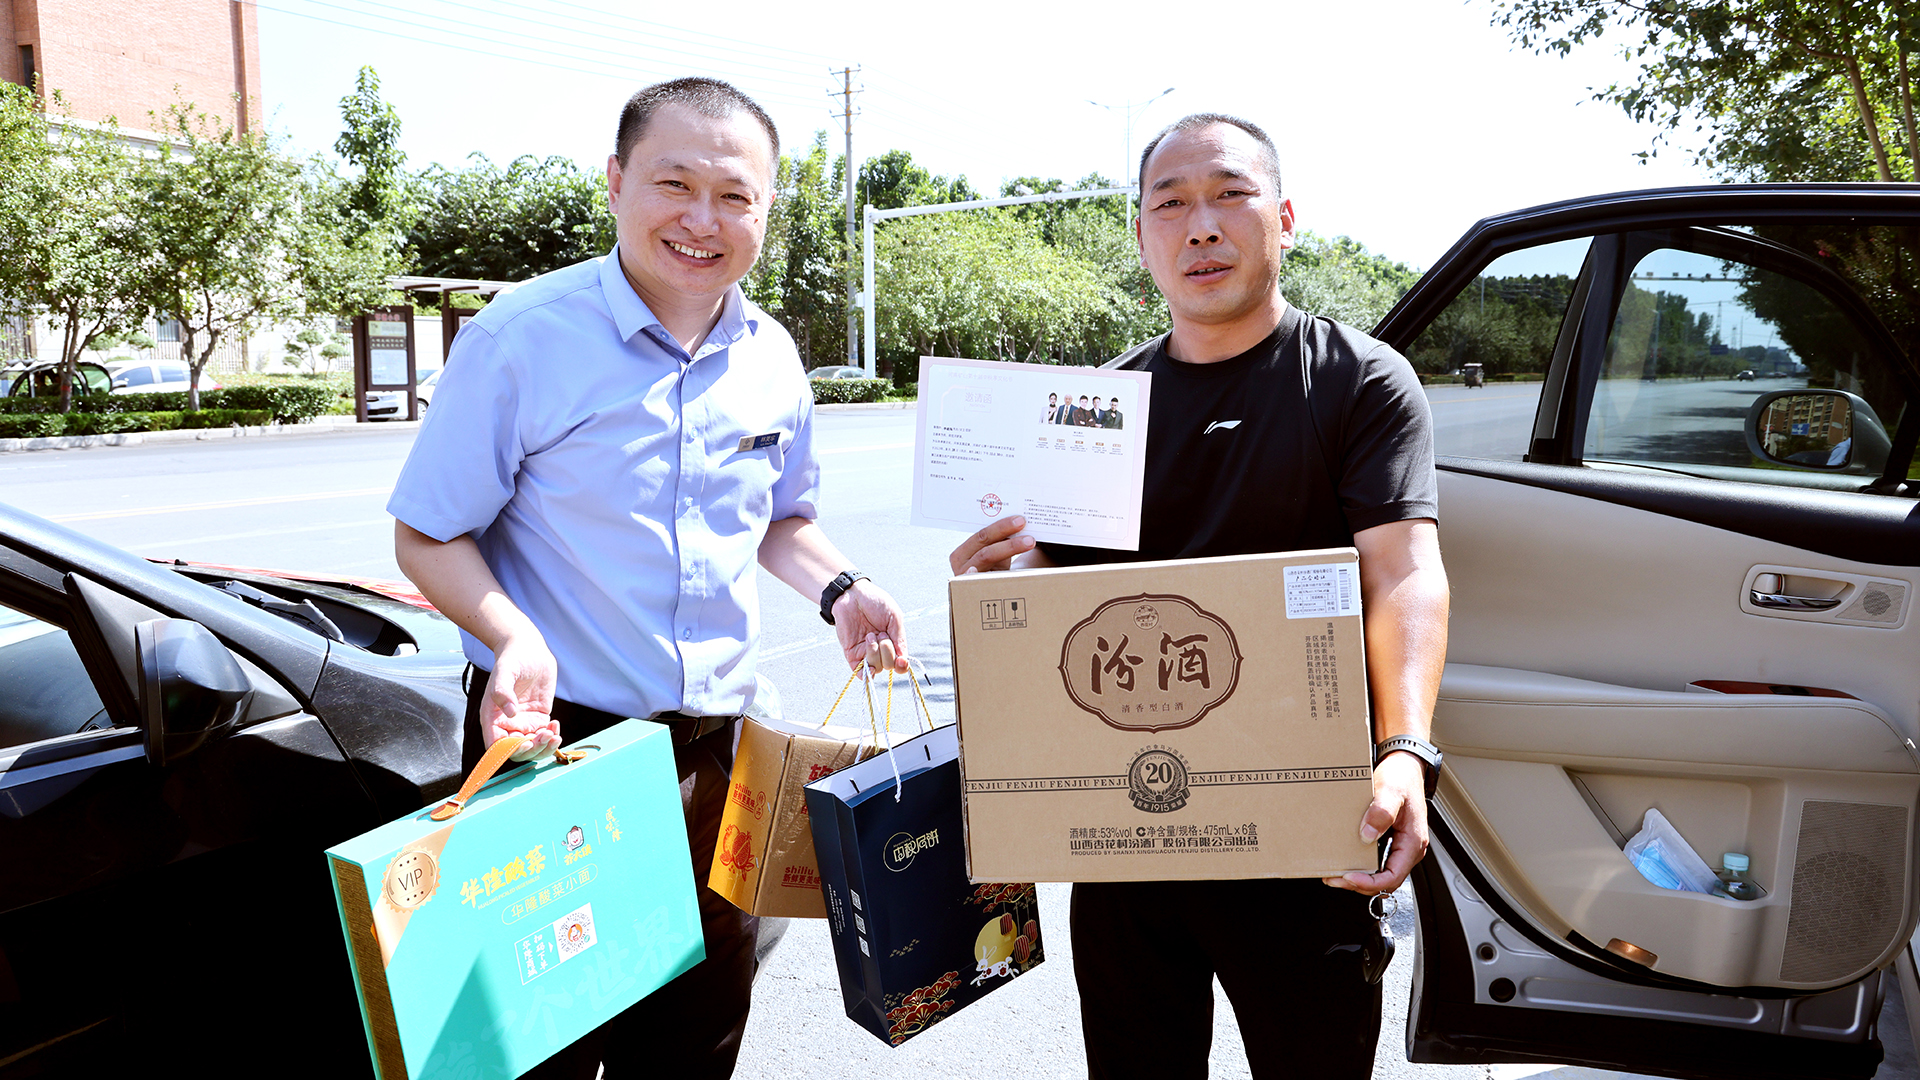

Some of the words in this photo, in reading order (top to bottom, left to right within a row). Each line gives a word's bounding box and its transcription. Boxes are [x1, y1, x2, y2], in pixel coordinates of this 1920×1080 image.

[1091, 631, 1211, 695] 汾酒
[1121, 702, 1185, 714] 清香型白酒
[1145, 762, 1172, 784] 20
[1188, 774, 1227, 783] ENJIU
[1230, 773, 1273, 782] FENJIU
[1277, 771, 1320, 781] FENJIU
[1324, 769, 1368, 779] FENJIU
[1006, 780, 1046, 789] FENJIU
[1050, 779, 1090, 788] FENJIU
[1151, 803, 1169, 812] 1915
[1070, 835, 1259, 850] 山西杏花村汾酒厂股份有限公司出品
[459, 844, 546, 909] 华隆酸菜
[785, 865, 814, 876] shiliu
[398, 868, 423, 891] VIP
[511, 868, 591, 918] 华隆酸菜小面
